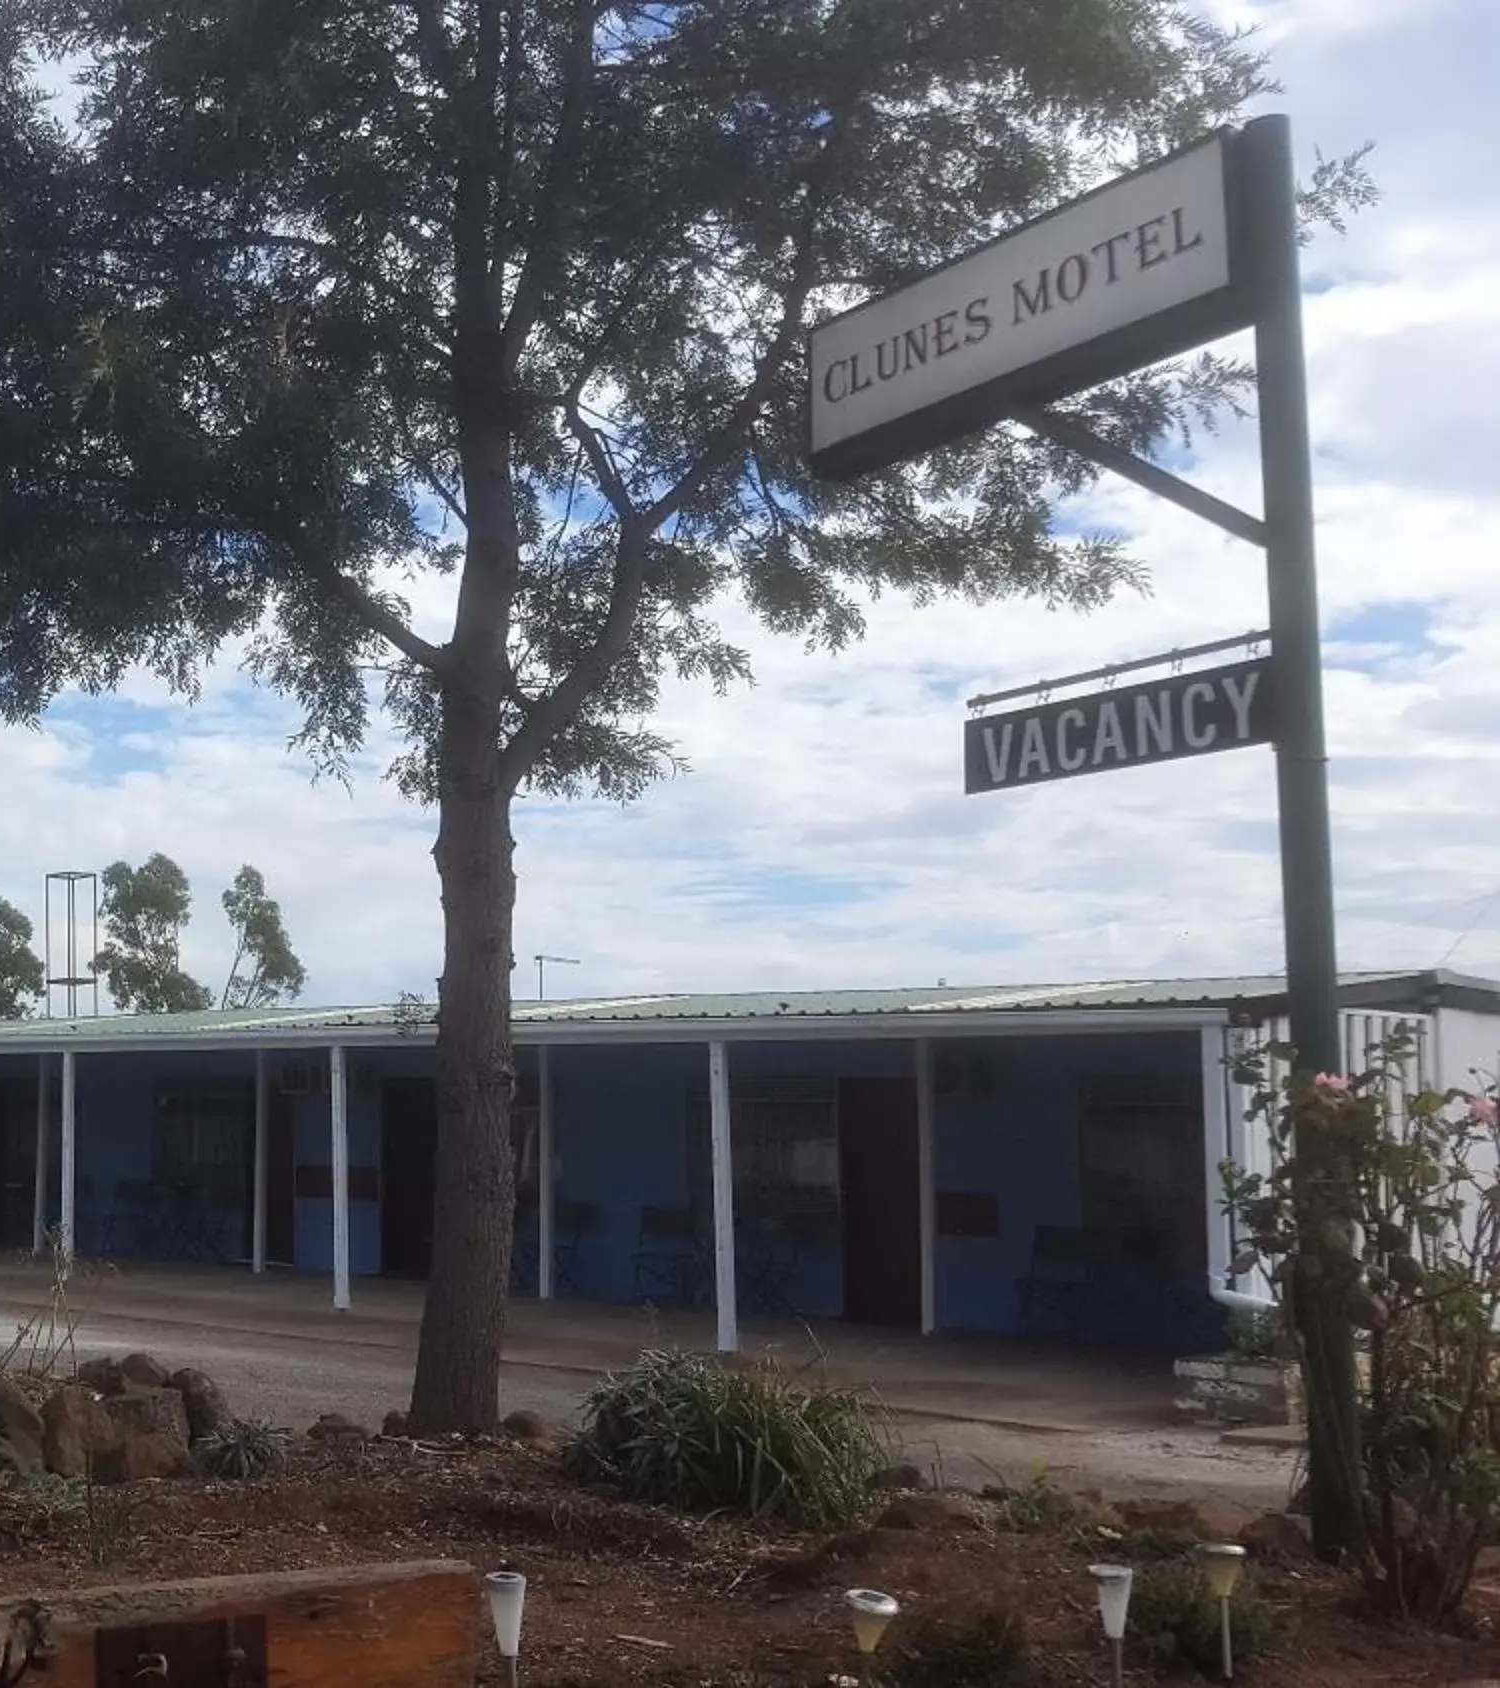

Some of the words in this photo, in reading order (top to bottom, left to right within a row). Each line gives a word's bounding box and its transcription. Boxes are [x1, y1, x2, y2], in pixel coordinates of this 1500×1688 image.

[823, 297, 992, 404] CLUNES
[1011, 207, 1205, 327] MOTEL
[982, 671, 1261, 784] VACANCY
